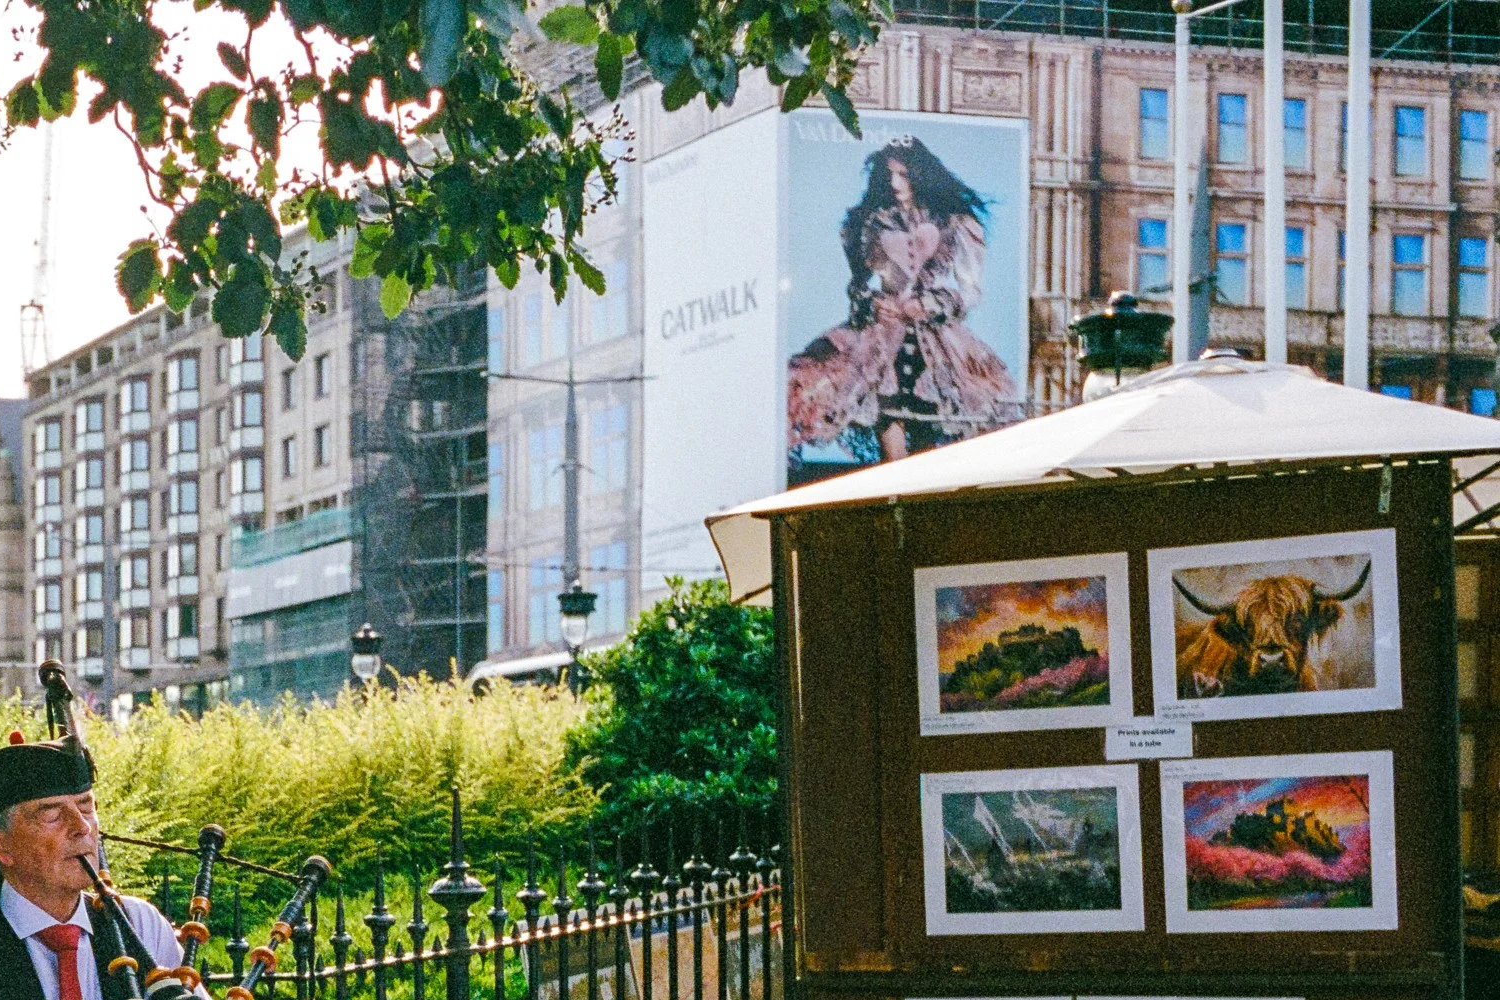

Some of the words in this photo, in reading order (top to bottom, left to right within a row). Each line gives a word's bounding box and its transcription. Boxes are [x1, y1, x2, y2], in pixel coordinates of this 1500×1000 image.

[661, 278, 758, 340] CATWALK
[1117, 729, 1140, 737] Prints
[1141, 727, 1176, 736] available
[1144, 739, 1162, 747] tube
